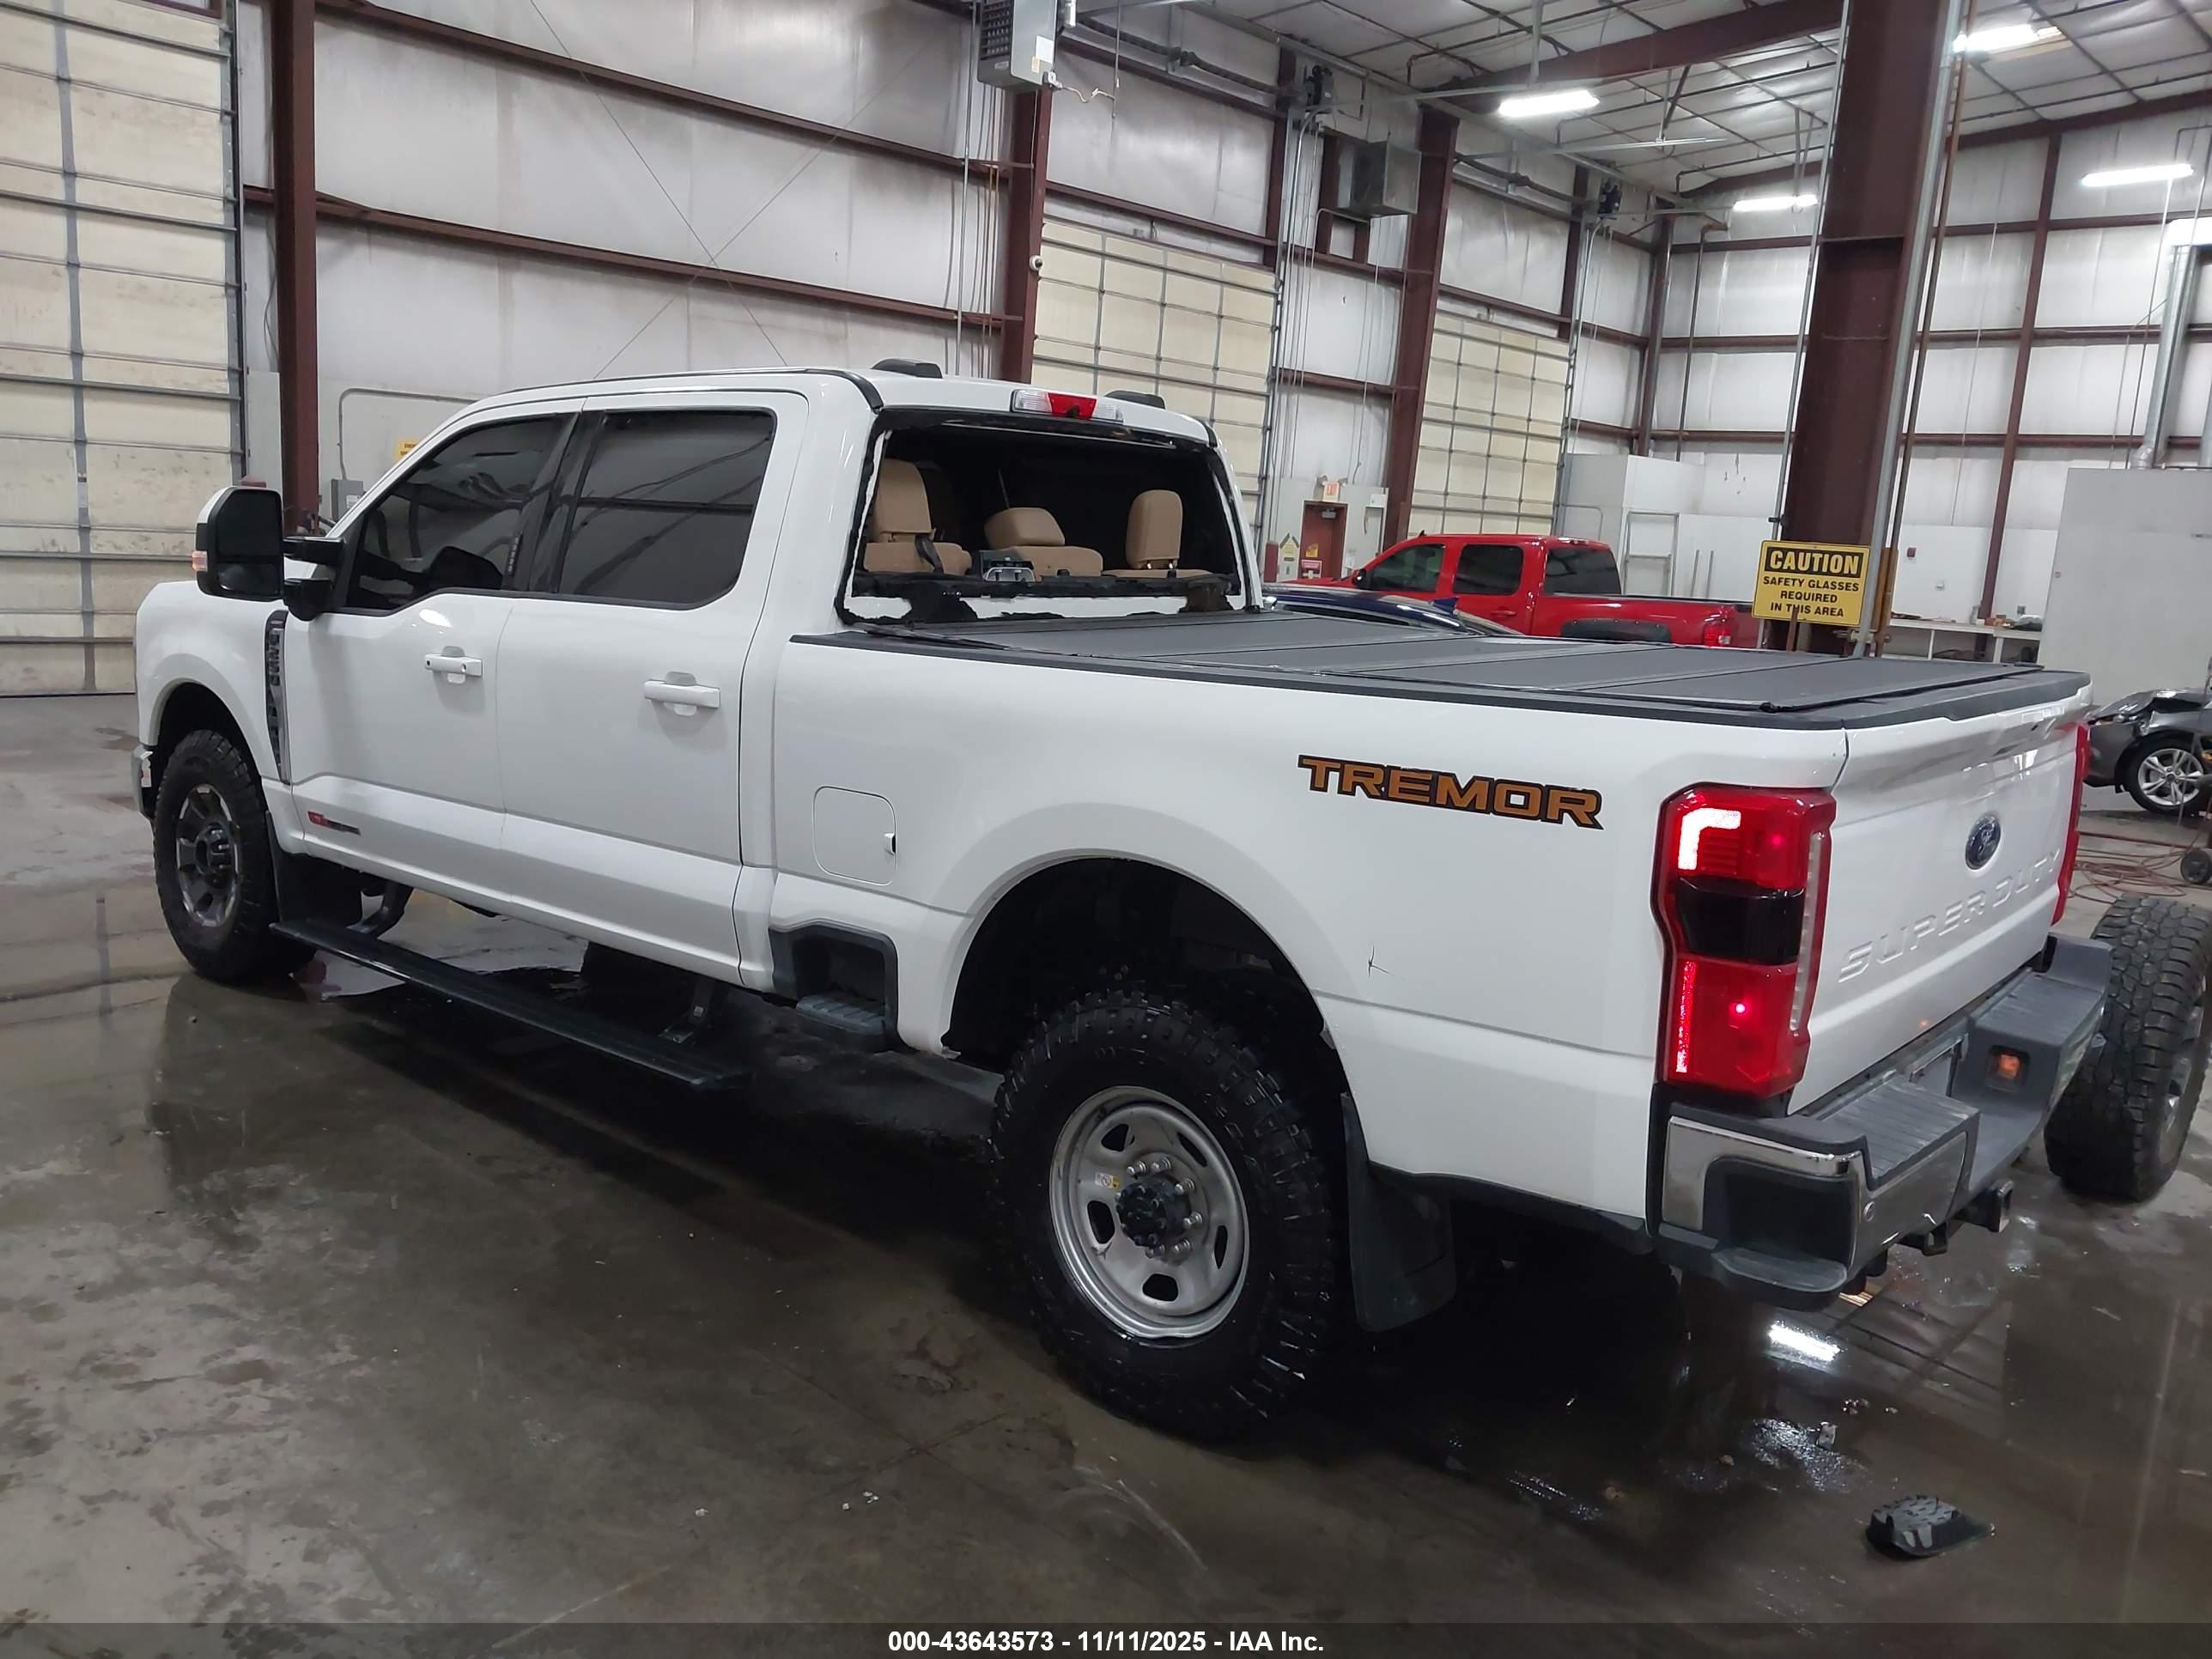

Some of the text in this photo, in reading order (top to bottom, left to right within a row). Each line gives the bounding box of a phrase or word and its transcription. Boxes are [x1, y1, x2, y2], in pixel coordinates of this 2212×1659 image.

[1770, 550, 1859, 574] CAUTION
[1763, 575, 1860, 592] SAFETY GLASSES
[1780, 590, 1838, 604] REQUIRED
[1770, 602, 1844, 617] IN THIS AREA
[1298, 755, 1604, 830] TREMOR
[1838, 890, 1986, 983] SUPER
